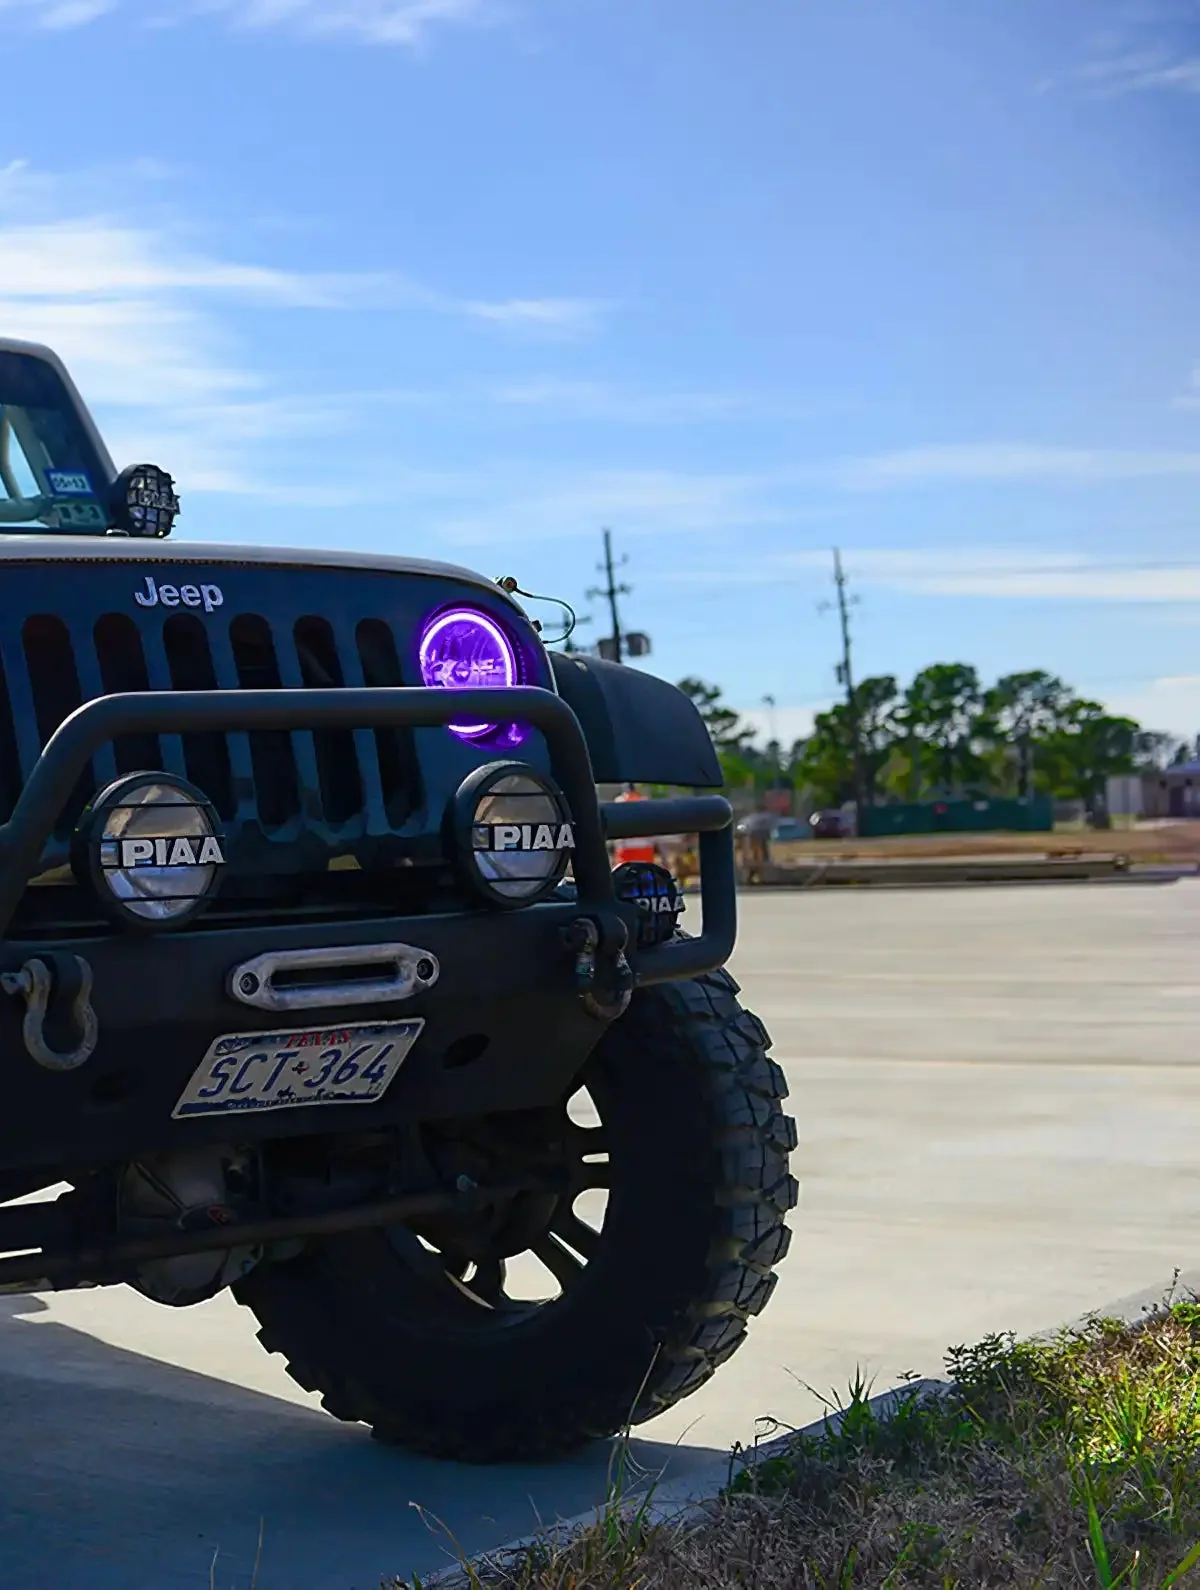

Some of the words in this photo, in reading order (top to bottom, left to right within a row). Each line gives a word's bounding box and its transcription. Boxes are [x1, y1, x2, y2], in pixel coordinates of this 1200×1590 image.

[133, 576, 224, 613] Jeep
[121, 836, 225, 868] PIAA
[493, 823, 577, 851] PIAA
[197, 1051, 300, 1099] SCT
[302, 1043, 395, 1089] 364
